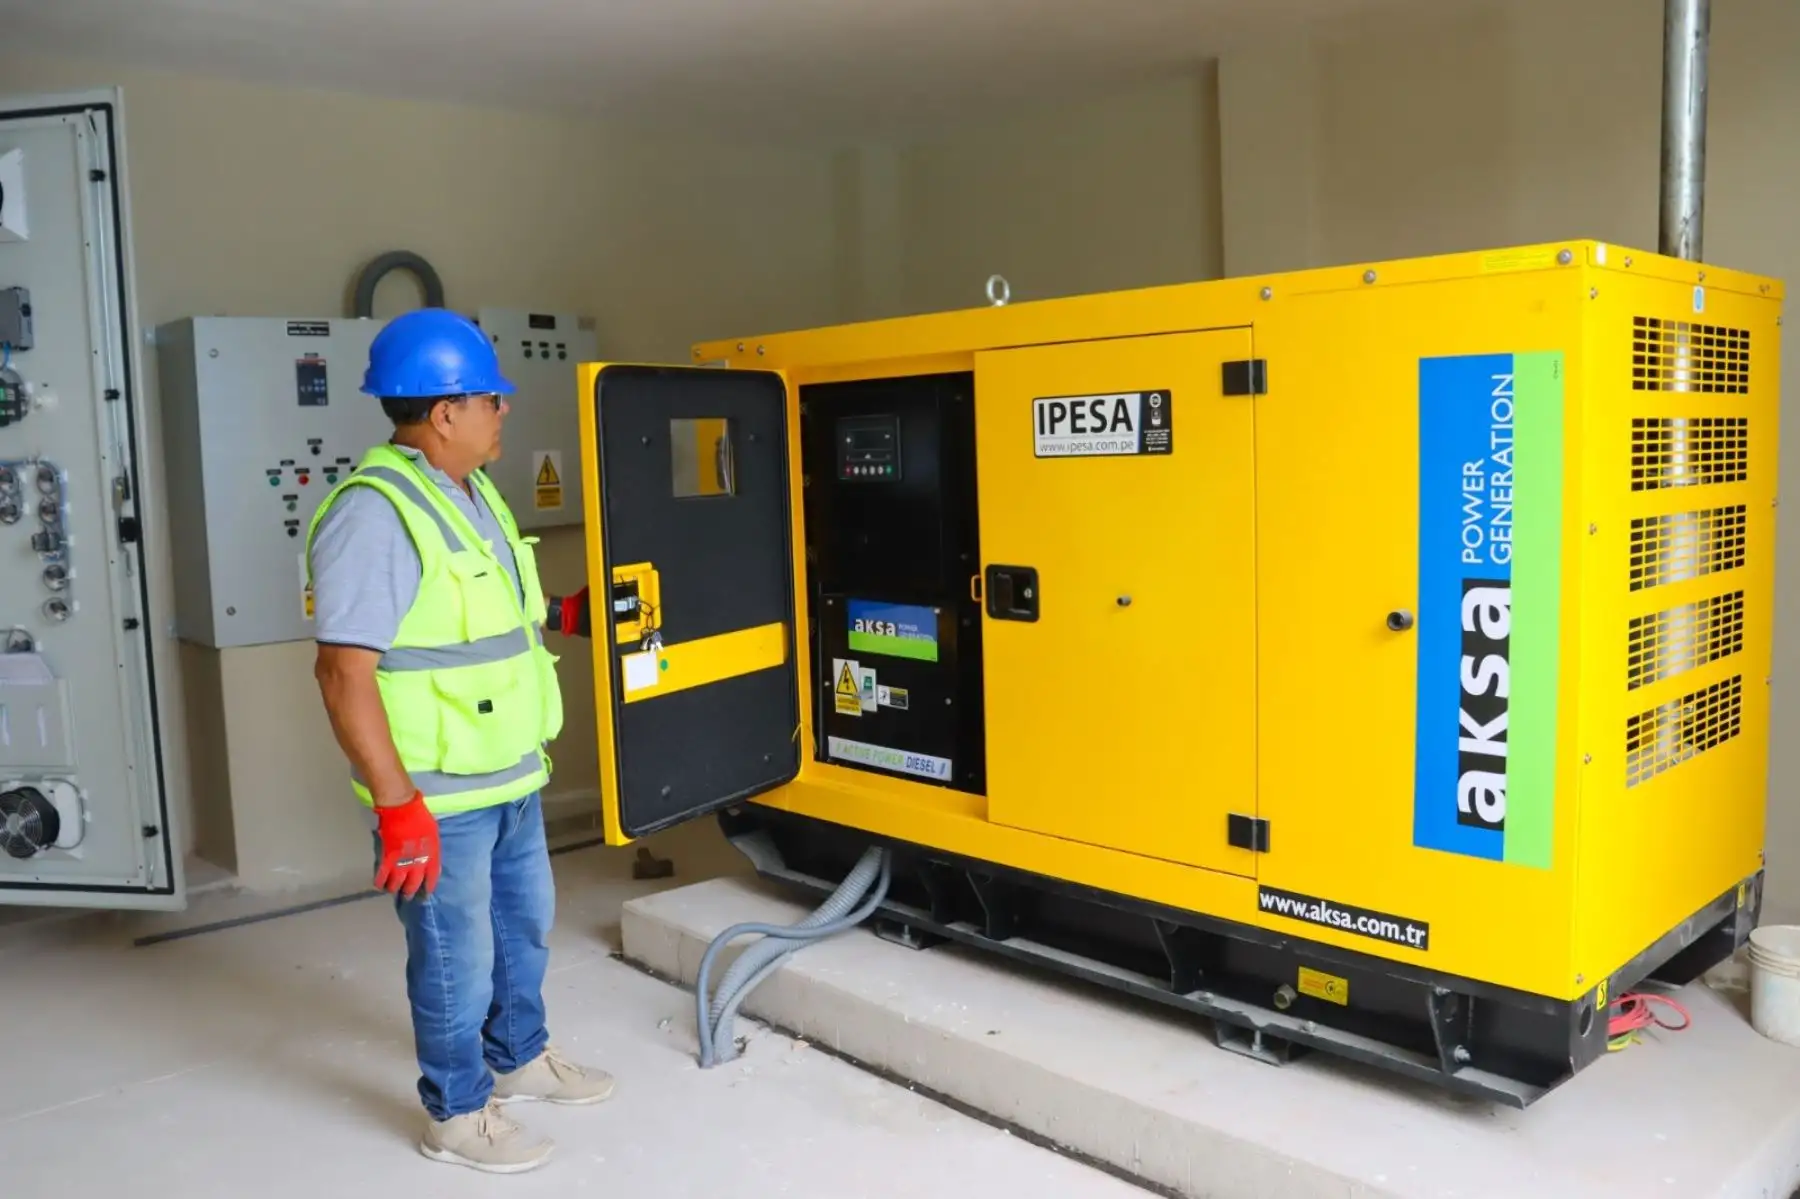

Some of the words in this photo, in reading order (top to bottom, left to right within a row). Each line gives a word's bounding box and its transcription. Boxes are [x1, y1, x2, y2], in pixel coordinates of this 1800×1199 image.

[1038, 398, 1133, 435] IPESA
[1040, 440, 1134, 453] www.ipesa.com.pe
[1490, 374, 1514, 564] GENERATION
[1462, 458, 1484, 564] POWER
[855, 618, 896, 637] aksa
[1457, 586, 1512, 824] aksa
[873, 749, 905, 765] POWER
[906, 756, 936, 774] DIESEL
[1259, 892, 1426, 945] www.aksa.com.tr
